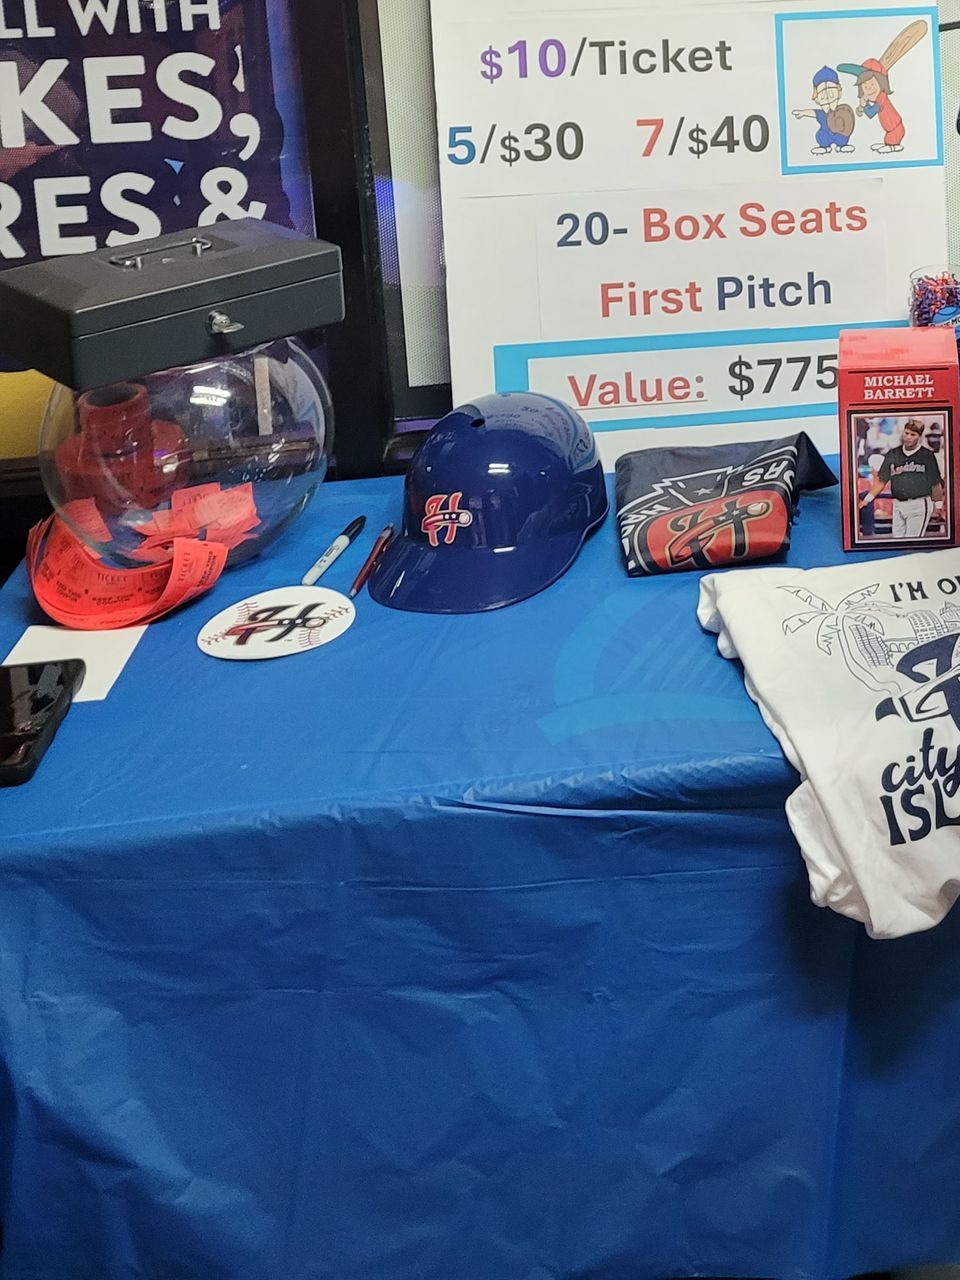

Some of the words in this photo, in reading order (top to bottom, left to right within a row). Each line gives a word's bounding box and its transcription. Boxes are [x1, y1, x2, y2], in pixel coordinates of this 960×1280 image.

[480, 37, 733, 83] $10/Ticket
[446, 121, 585, 167] 5/$30
[636, 115, 771, 160] 7/$40
[556, 211, 630, 248] 20-
[642, 207, 726, 245] Box
[739, 199, 869, 239] Seats
[600, 279, 703, 318] First
[715, 270, 833, 311] Pitch
[567, 373, 707, 410] Value:
[727, 354, 839, 403] $775
[864, 374, 934, 388] MICHAEL
[864, 386, 935, 400] BARRETT
[889, 581, 929, 603] I'M
